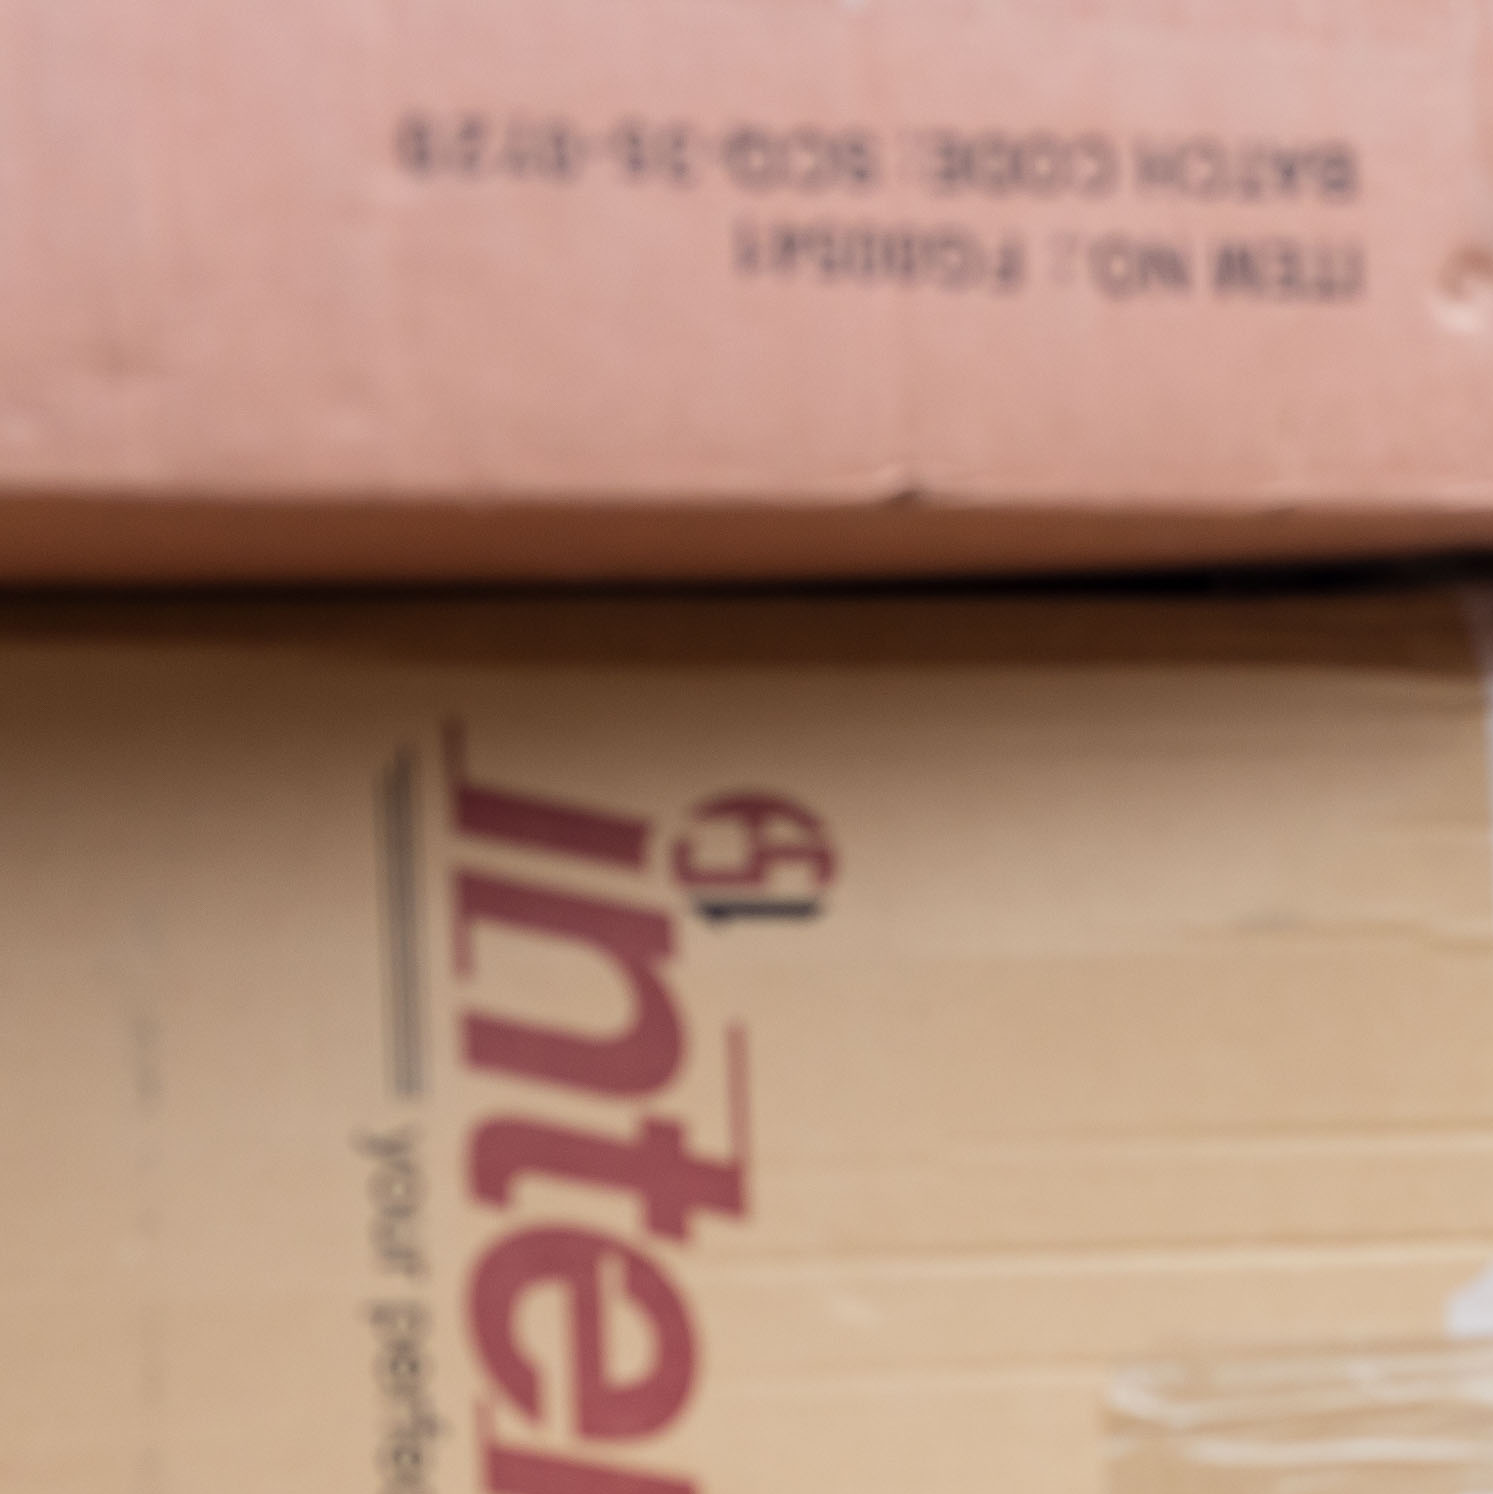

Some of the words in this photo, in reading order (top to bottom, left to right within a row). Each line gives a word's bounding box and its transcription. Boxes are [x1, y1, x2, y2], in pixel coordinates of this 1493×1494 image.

[1134, 138, 1361, 202] BATCH
[1209, 240, 1366, 299] ITEM
[348, 1123, 430, 1282] your
